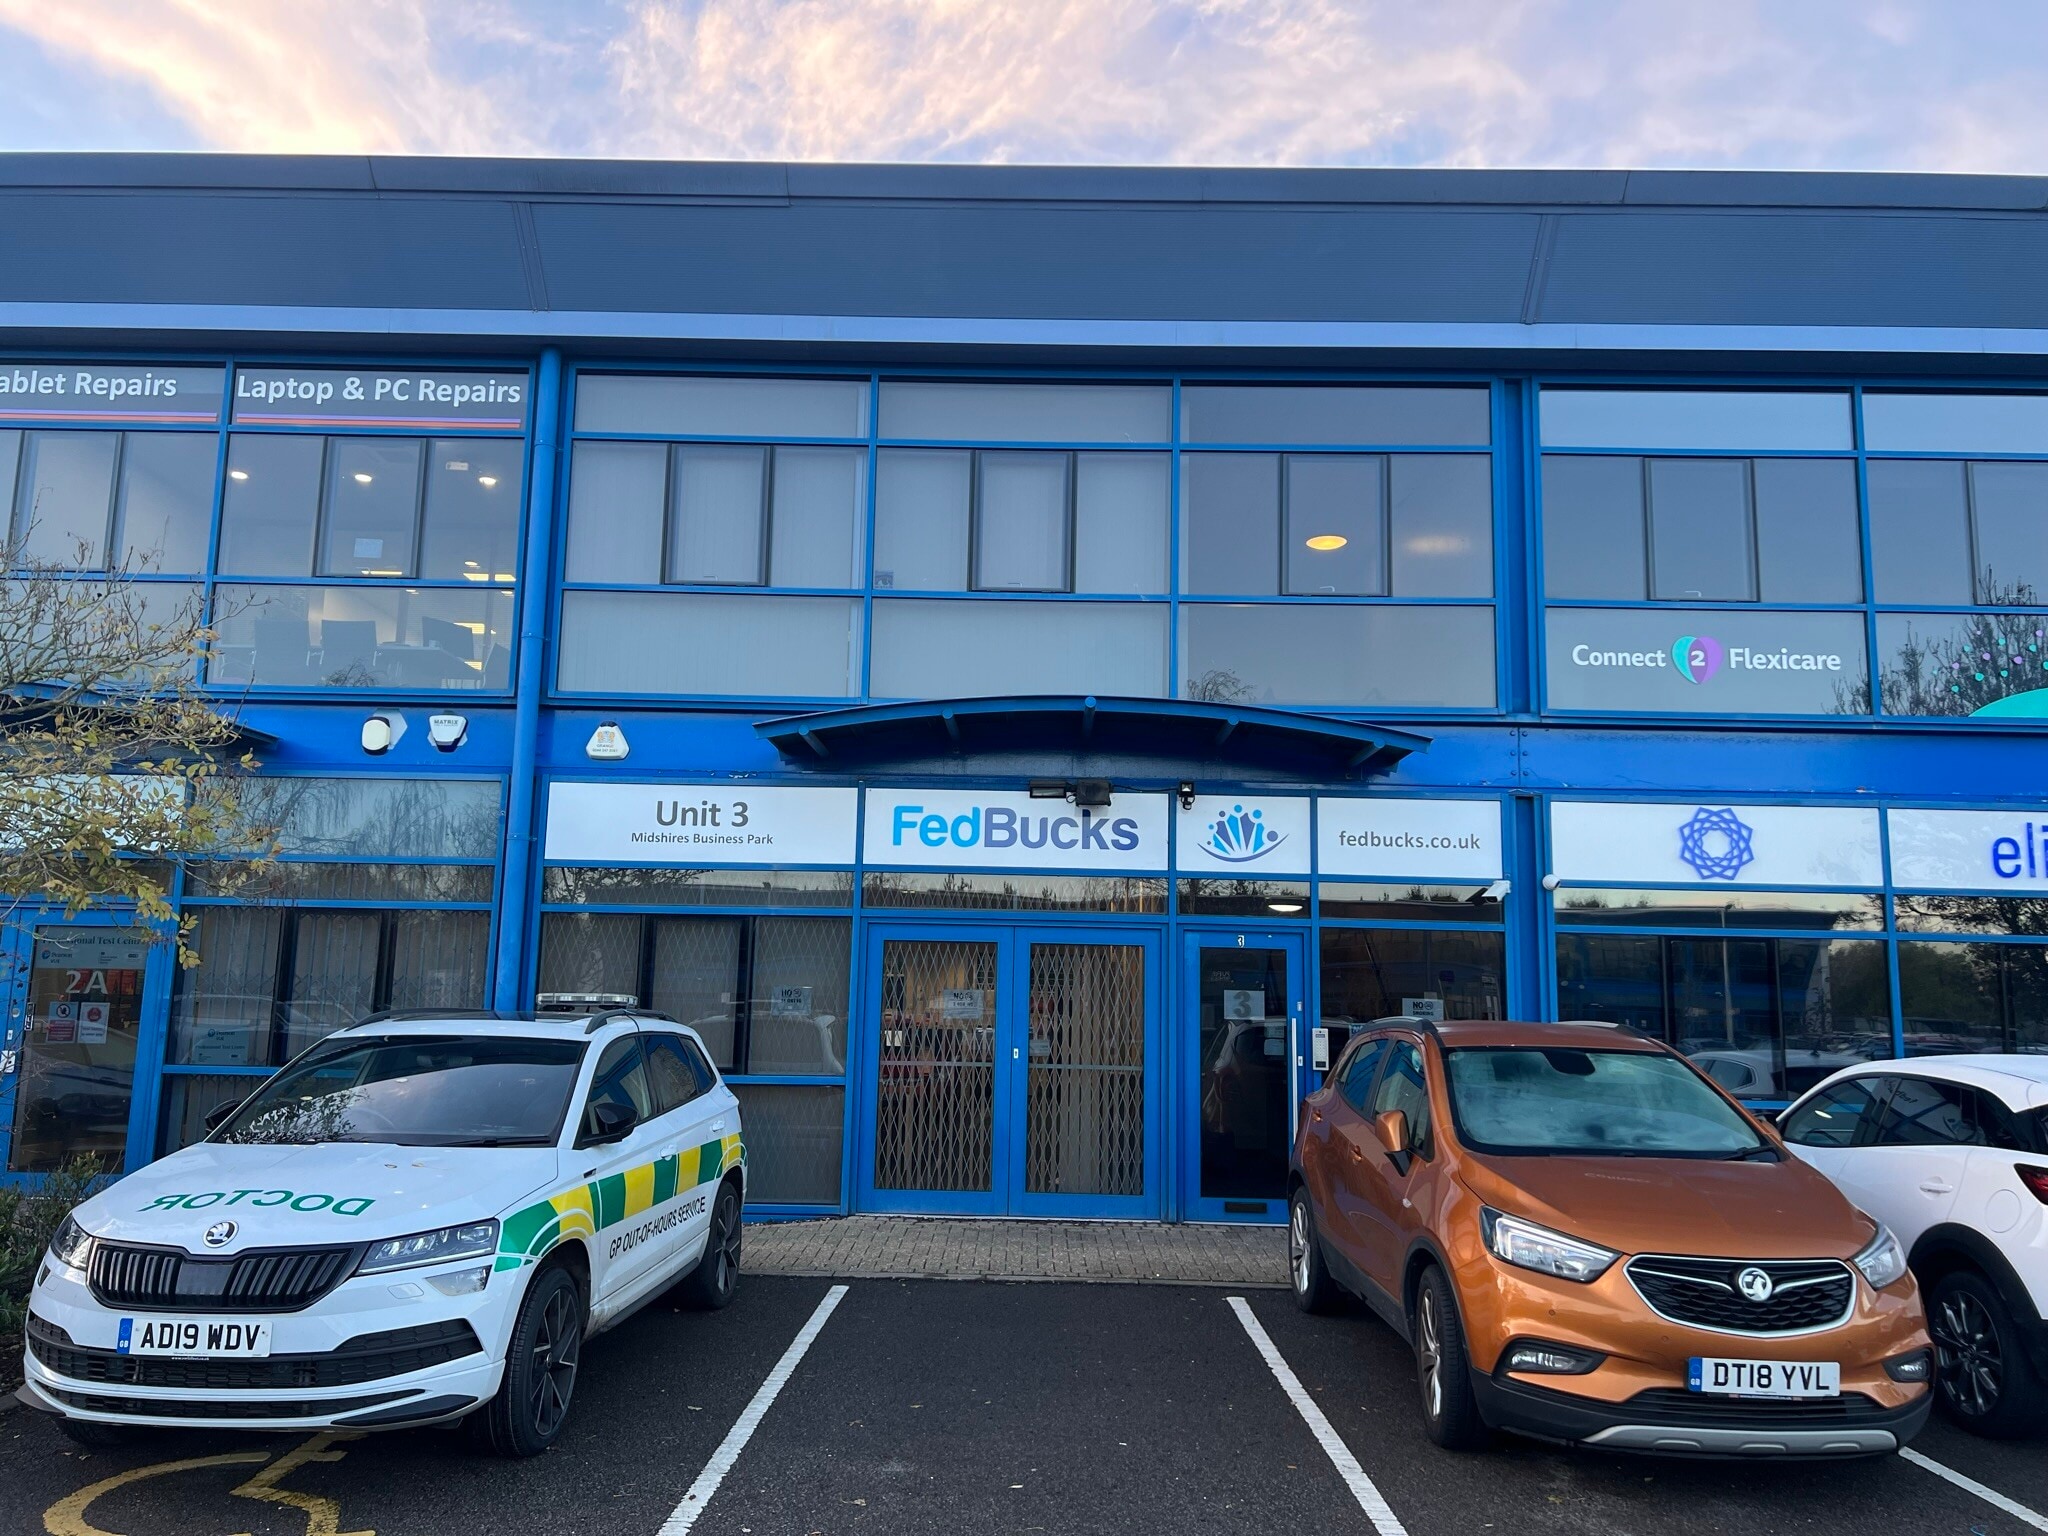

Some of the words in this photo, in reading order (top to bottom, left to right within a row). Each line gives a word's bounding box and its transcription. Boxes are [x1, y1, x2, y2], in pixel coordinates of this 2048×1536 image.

[0, 370, 66, 394] ablet
[75, 372, 177, 401] Repairs
[237, 375, 334, 405] Laptop
[342, 376, 365, 400] &
[374, 378, 410, 401] PC
[418, 379, 521, 407] Repairs
[1571, 644, 1666, 667] Connect
[1691, 650, 1706, 667] 2
[1729, 648, 1841, 671] Flexicare
[656, 800, 721, 827] Unit
[731, 801, 749, 827] 3
[631, 832, 689, 843] Midshires
[693, 833, 744, 844] Business
[747, 834, 773, 845] Park
[893, 805, 1139, 851] FedBucks
[1339, 830, 1480, 849] fedbucks.co.uk
[1992, 822, 2048, 878] eli
[42, 936, 95, 946] Pional
[98, 936, 115, 945] Test
[65, 970, 109, 995] 2A
[1233, 990, 1251, 1018] 3
[1412, 1001, 1423, 1009] NO
[609, 1236, 621, 1259] GP
[623, 1208, 677, 1252] OUT-OF-HOURS
[678, 1196, 706, 1224] SERVICE
[119, 1340, 129, 1348] GB
[140, 1322, 199, 1350] AD19
[207, 1324, 261, 1351] WDV
[1690, 1378, 1701, 1386] GB
[1713, 1362, 1772, 1389] DT18
[1781, 1365, 1830, 1391] YVL
